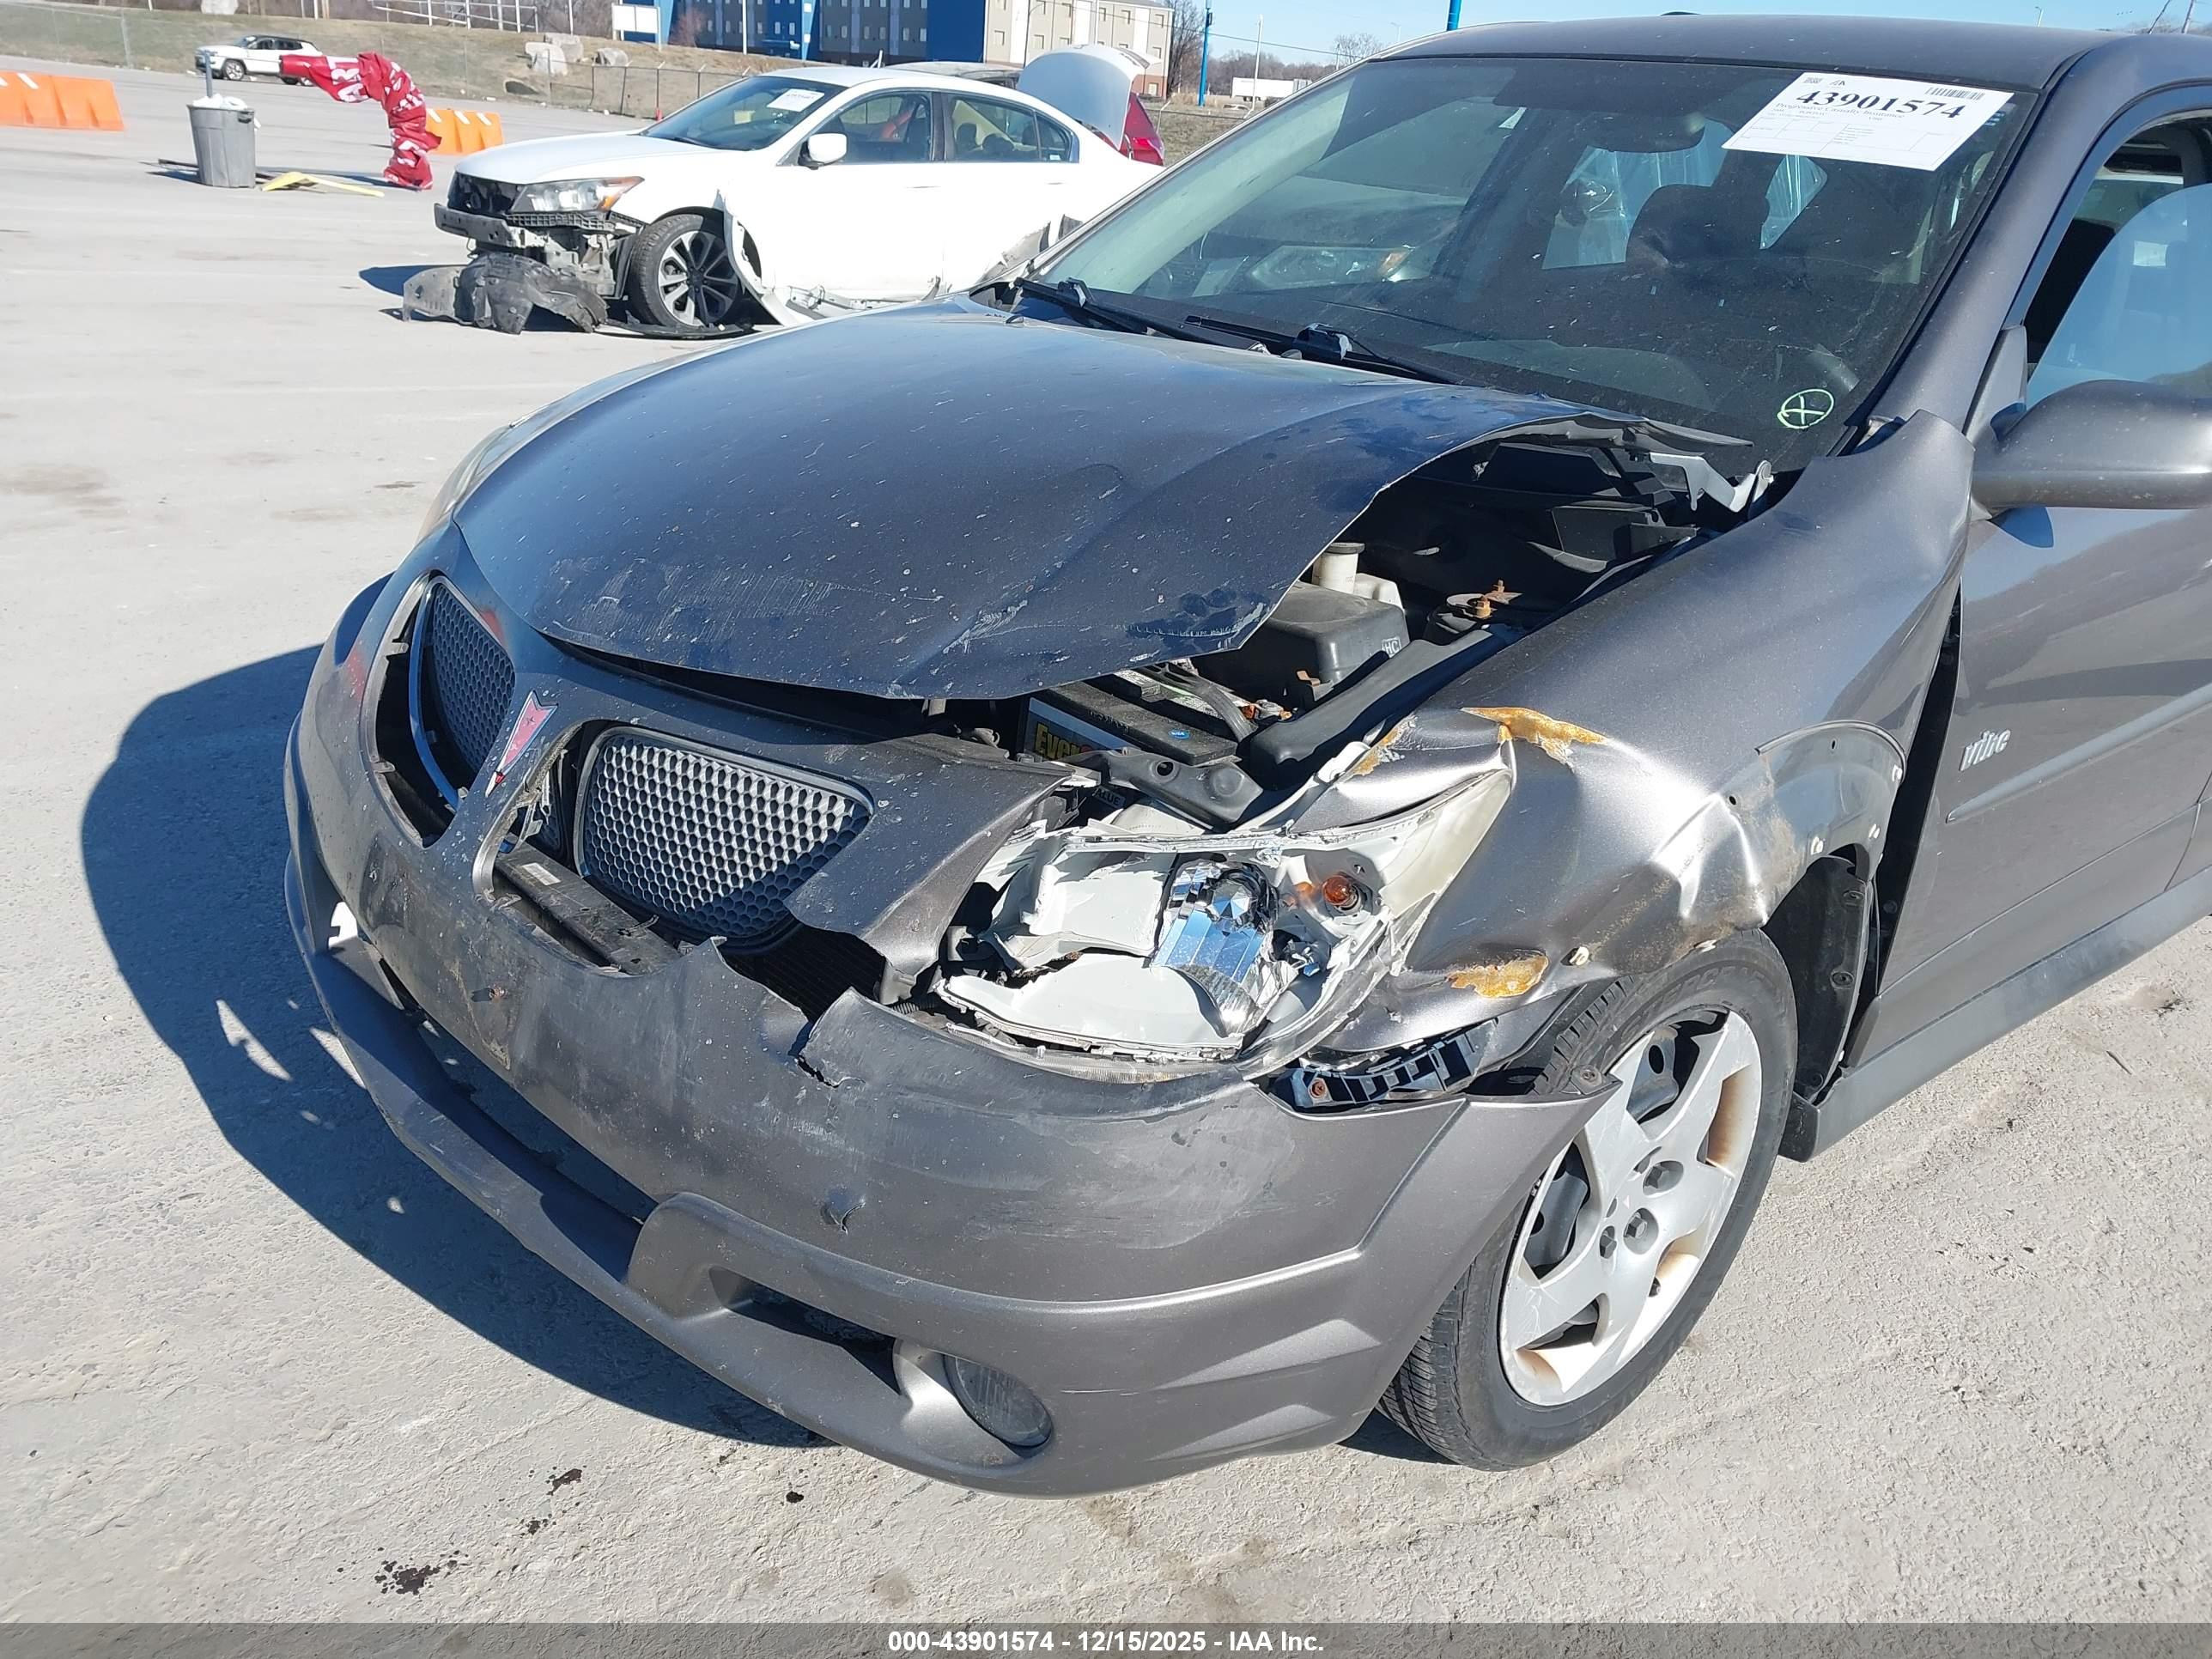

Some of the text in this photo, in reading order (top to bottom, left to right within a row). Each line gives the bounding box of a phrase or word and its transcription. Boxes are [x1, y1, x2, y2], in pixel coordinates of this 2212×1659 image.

[1796, 90, 1965, 118] 43901574
[1035, 723, 1093, 759] Ever
[1096, 787, 1121, 805] ALUE
